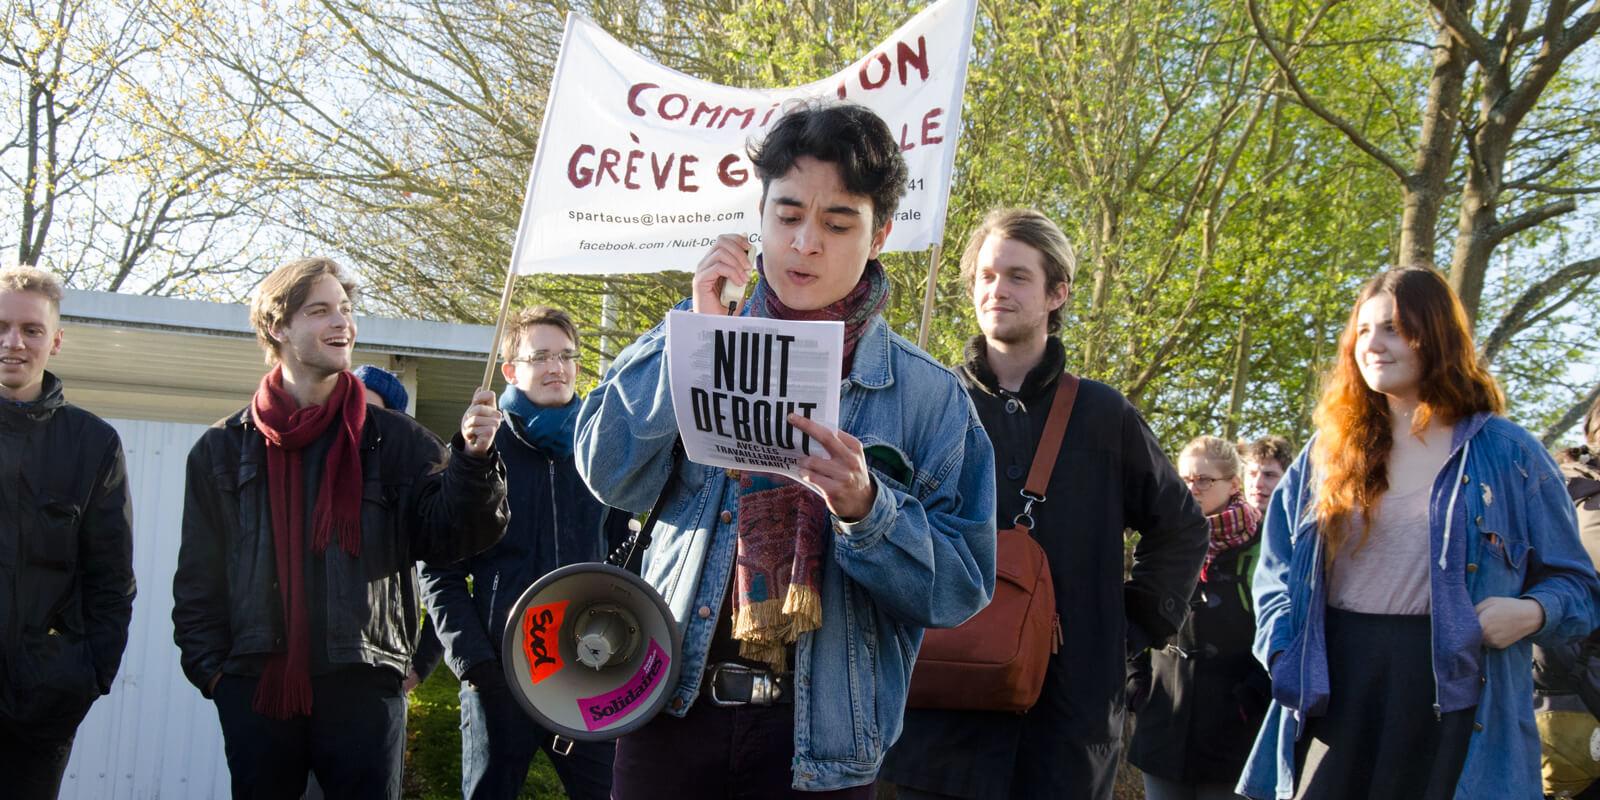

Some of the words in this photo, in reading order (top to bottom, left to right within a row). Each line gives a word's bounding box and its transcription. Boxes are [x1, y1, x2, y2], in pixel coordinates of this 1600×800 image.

[567, 131, 700, 193] GRÈVE
[568, 210, 745, 226] spartacus@lavache.com
[579, 239, 665, 251] facebook.com
[714, 329, 795, 398] NUIT
[691, 386, 817, 457] DEBOUT
[736, 441, 761, 452] AVEC
[762, 447, 780, 455] LES
[734, 456, 747, 464] DE
[748, 458, 791, 470] RENAULT
[530, 609, 556, 668] Sud
[589, 656, 664, 721] Solidaires
